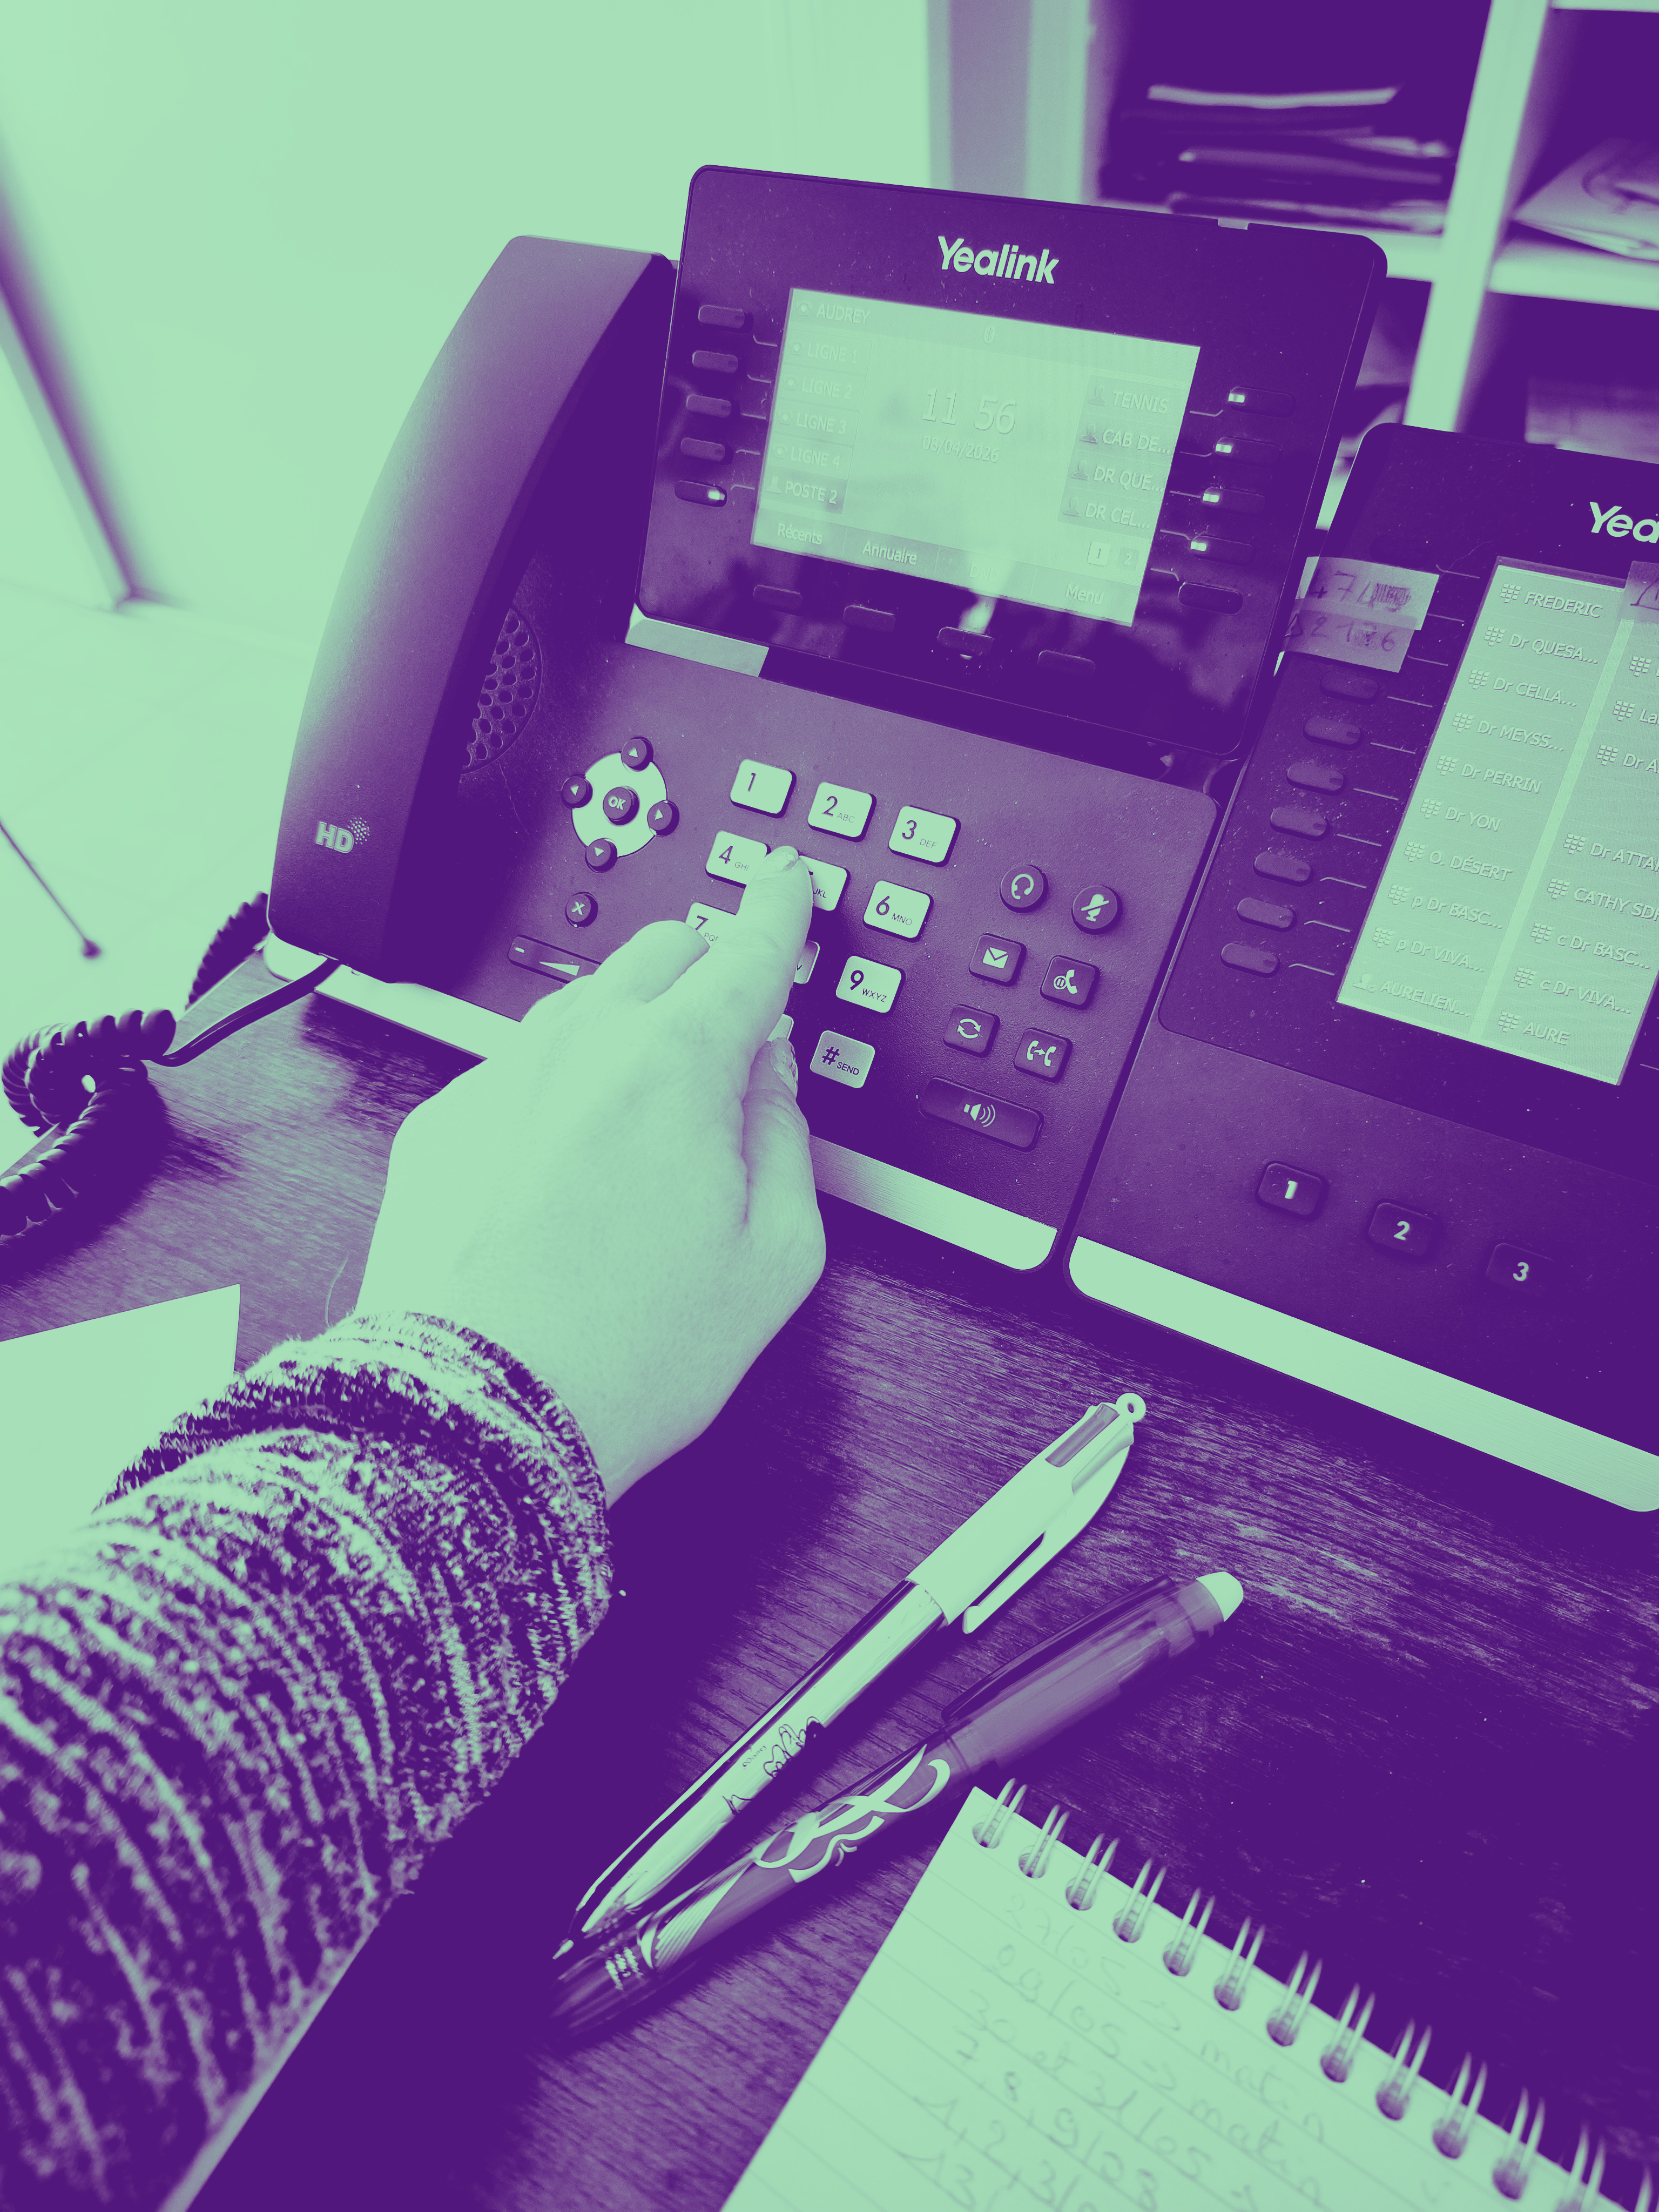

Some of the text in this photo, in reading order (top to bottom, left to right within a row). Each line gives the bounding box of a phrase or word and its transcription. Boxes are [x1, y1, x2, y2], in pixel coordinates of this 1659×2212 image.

[938, 236, 1059, 285] Yealink
[816, 304, 871, 324] AUDREY
[807, 343, 858, 364] LIGNE 1
[801, 377, 853, 399] LIGNE 2
[922, 387, 1017, 435] 11 56
[1112, 390, 1169, 414] TENNIS
[796, 412, 847, 435] LIGNE 3
[922, 435, 1000, 463] 08/04/2026
[1102, 429, 1171, 454] CAB DE...
[790, 447, 841, 469] LIGNE 4
[785, 481, 838, 504] POSTE 2
[1094, 466, 1164, 494] DR QUE...
[1085, 502, 1150, 529] DR CEL...
[777, 523, 823, 545] Récents
[862, 541, 918, 565] Annuaire
[1095, 548, 1132, 566] 1 2
[969, 565, 1000, 583] DND
[1065, 583, 1104, 605] Menu
[1524, 591, 1603, 618] FREDERIC
[1508, 634, 1599, 664] Dr QUESA...
[1493, 677, 1577, 707] Dr CELLA...
[1477, 720, 1564, 751] Dr MEYSS...
[1623, 753, 1644, 769] Dr
[746, 772, 757, 793] 1
[1461, 763, 1542, 794] Dr PERRIN
[609, 795, 626, 811] OK
[822, 795, 855, 824] 2 ABC
[1445, 806, 1502, 832] Dr YON
[316, 821, 354, 854] HD
[901, 820, 938, 850] 3 DEF
[718, 846, 750, 872] 4 GHI
[1589, 842, 1611, 859] Dr
[1429, 850, 1513, 882] O. DÉSERT
[875, 895, 913, 927] 6 MNO
[1412, 895, 1503, 929] p Dr BASC...
[1573, 887, 1631, 913] CATHY
[1395, 939, 1485, 973] p Dr VIVA...
[1570, 935, 1591, 952] Dr
[1593, 941, 1651, 970] BASC...
[849, 969, 887, 1003] 9 WXYZ
[1379, 979, 1469, 1017] AURELIEN...
[1553, 980, 1573, 996] Dr
[1577, 986, 1632, 1015] VIVA...
[1522, 1021, 1571, 1046] AURE
[837, 1061, 859, 1076] SEND
[1285, 1180, 1298, 1199] 1
[1393, 1220, 1410, 1241] 2
[1513, 1262, 1529, 1282] 3
